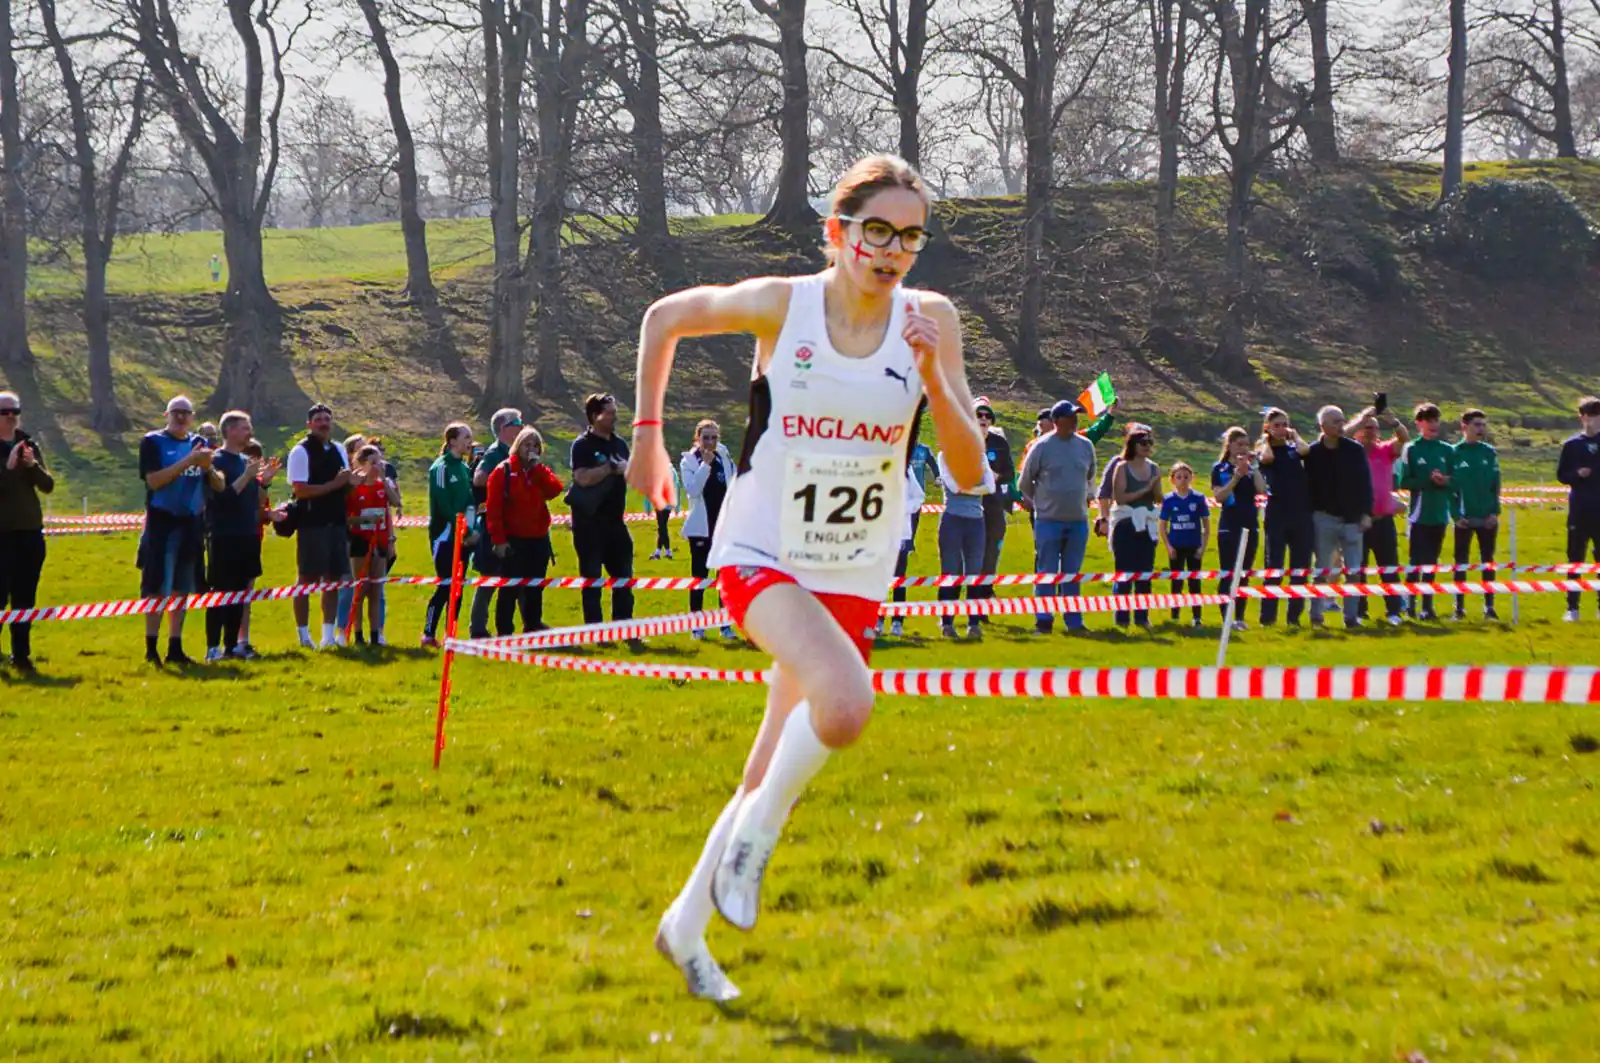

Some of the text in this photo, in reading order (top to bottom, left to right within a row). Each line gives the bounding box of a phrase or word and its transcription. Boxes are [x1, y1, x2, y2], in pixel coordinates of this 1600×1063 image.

[782, 415, 905, 446] ENGLAND
[180, 465, 201, 477] ISA
[793, 483, 885, 525] 126
[804, 529, 868, 544] ENGLAND
